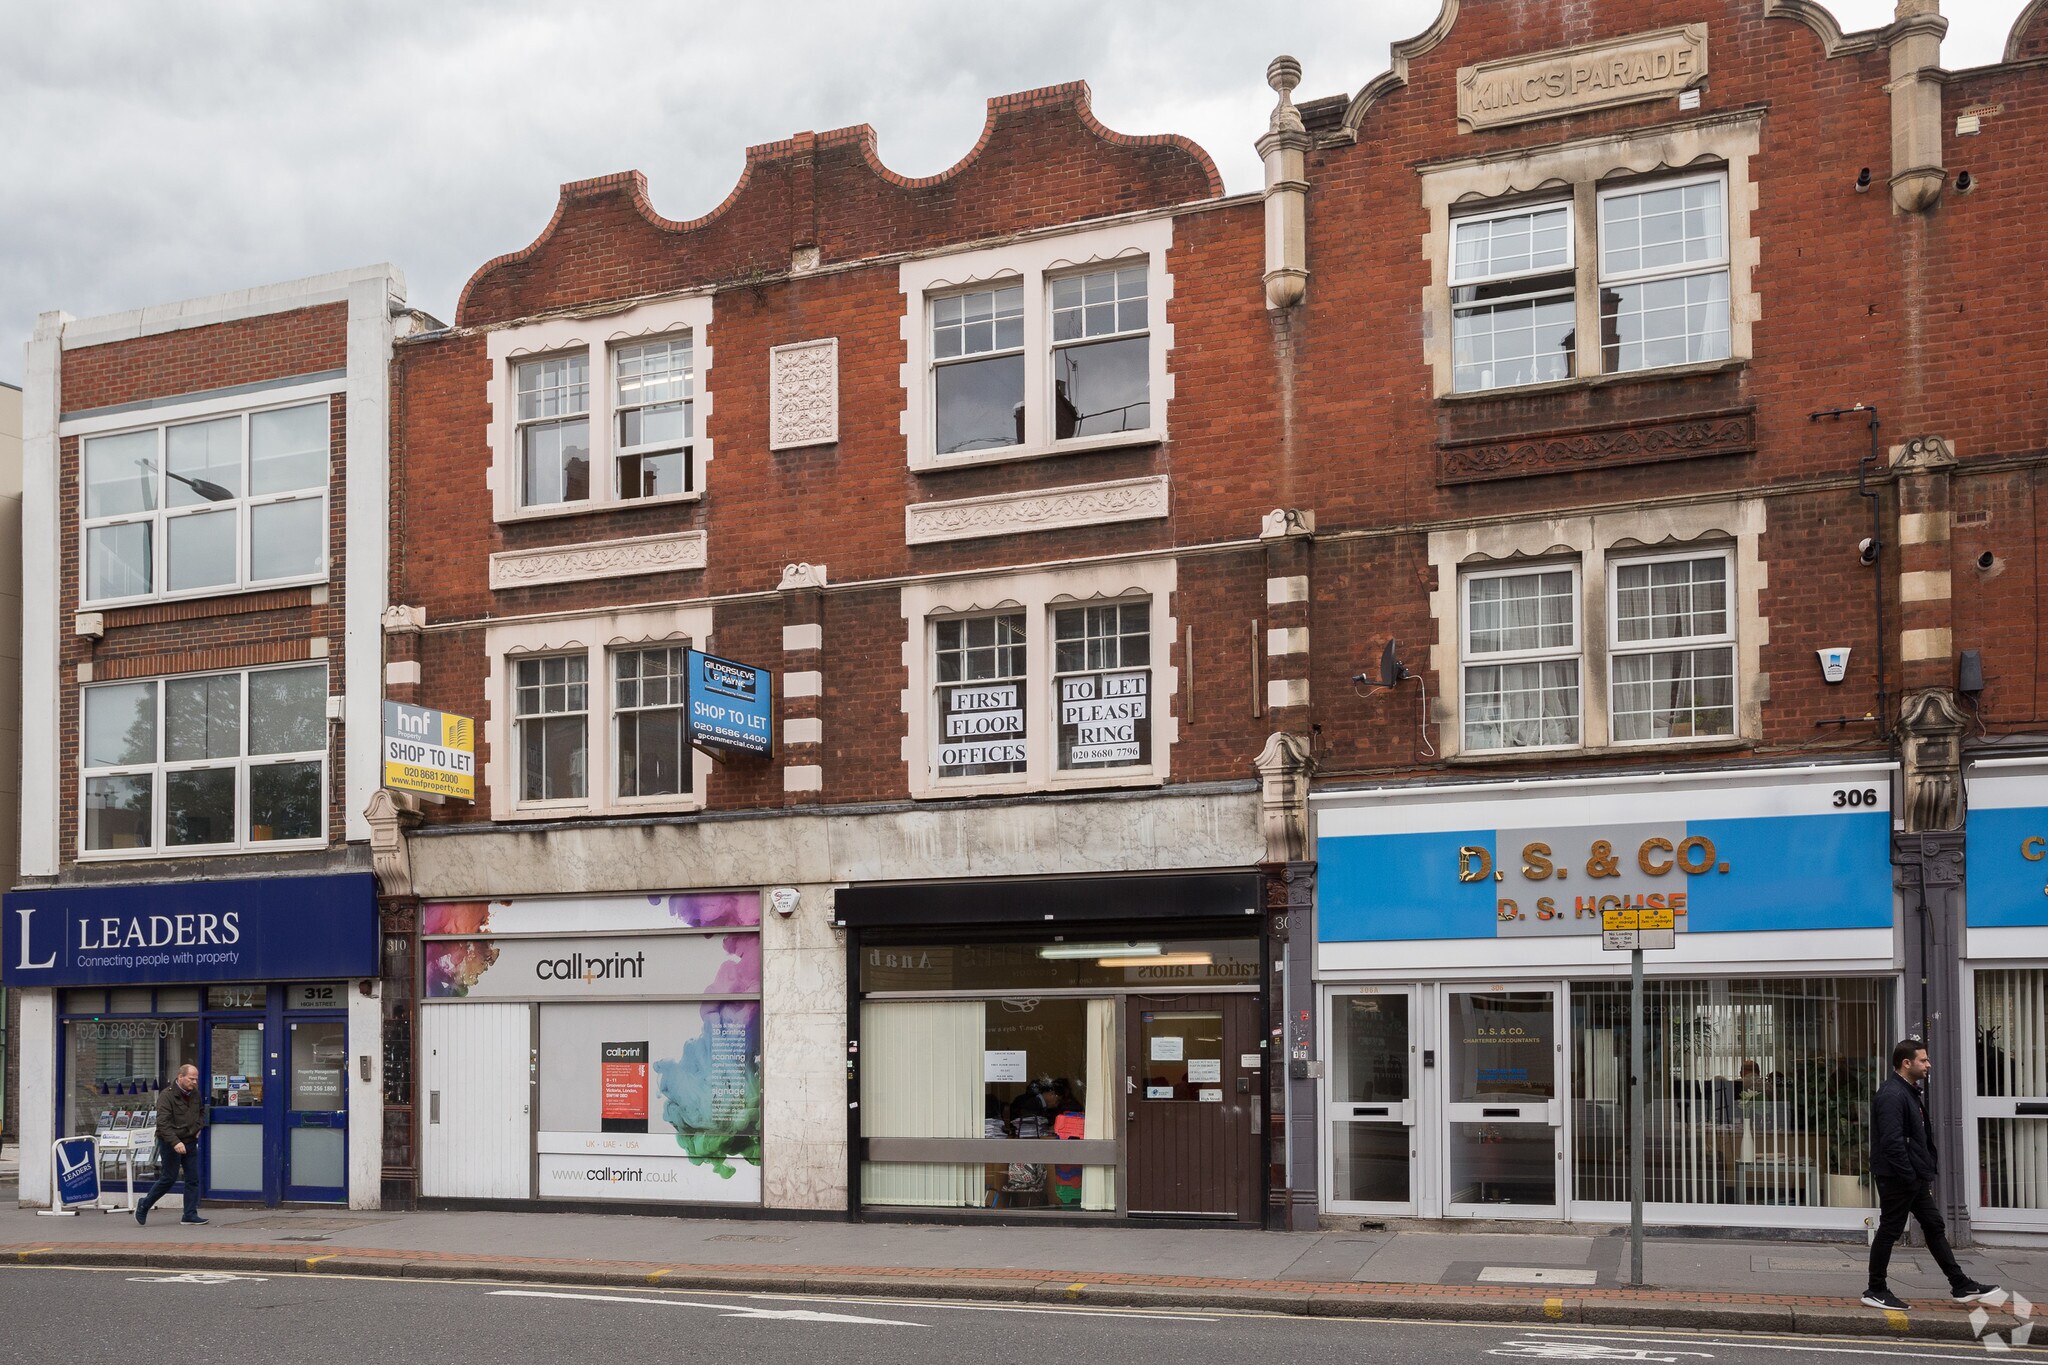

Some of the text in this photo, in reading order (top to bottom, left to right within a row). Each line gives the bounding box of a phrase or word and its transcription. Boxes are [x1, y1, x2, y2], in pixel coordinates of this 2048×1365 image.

[1571, 48, 1693, 95] PARADE
[704, 661, 755, 680] GILDERSLEVE
[722, 676, 745, 688] PAYNE
[1065, 677, 1144, 699] TO LET
[957, 691, 1014, 709] FIRST
[397, 706, 430, 735] hnf
[694, 701, 766, 730] SHOP TO LET
[1066, 702, 1143, 723] PLEASE
[693, 721, 767, 744] 020 8686 4400
[953, 716, 1019, 735] FLOOR
[1081, 725, 1132, 744] RING
[397, 730, 422, 741] Property
[697, 732, 764, 752] gpcommercial.co.uk
[390, 742, 471, 772] SHOP TO LET
[942, 744, 1026, 765] OFFICES
[1073, 747, 1138, 760] 020 8680 7796
[404, 767, 459, 784] 020 8681 2000
[391, 776, 470, 795] www.hnfproperty.com
[1833, 788, 1878, 807] 306
[1459, 835, 1730, 883] D. S. & CO.
[1497, 893, 1688, 921] D. S. HOUSE
[15, 909, 240, 970] L LEADERS
[386, 939, 407, 951] 310
[77, 951, 240, 969] Connecting people with property
[223, 988, 253, 1007] 312
[304, 988, 333, 999] 312
[80, 1023, 106, 1040] 020
[150, 1022, 184, 1039] 7941
[722, 1029, 746, 1037] printing
[712, 1054, 746, 1062] scanning
[712, 1088, 745, 1096] signage
[586, 1140, 595, 1148] UK
[63, 1163, 92, 1183] LEADERS
[552, 1167, 678, 1184] www.callprint.co.uk
